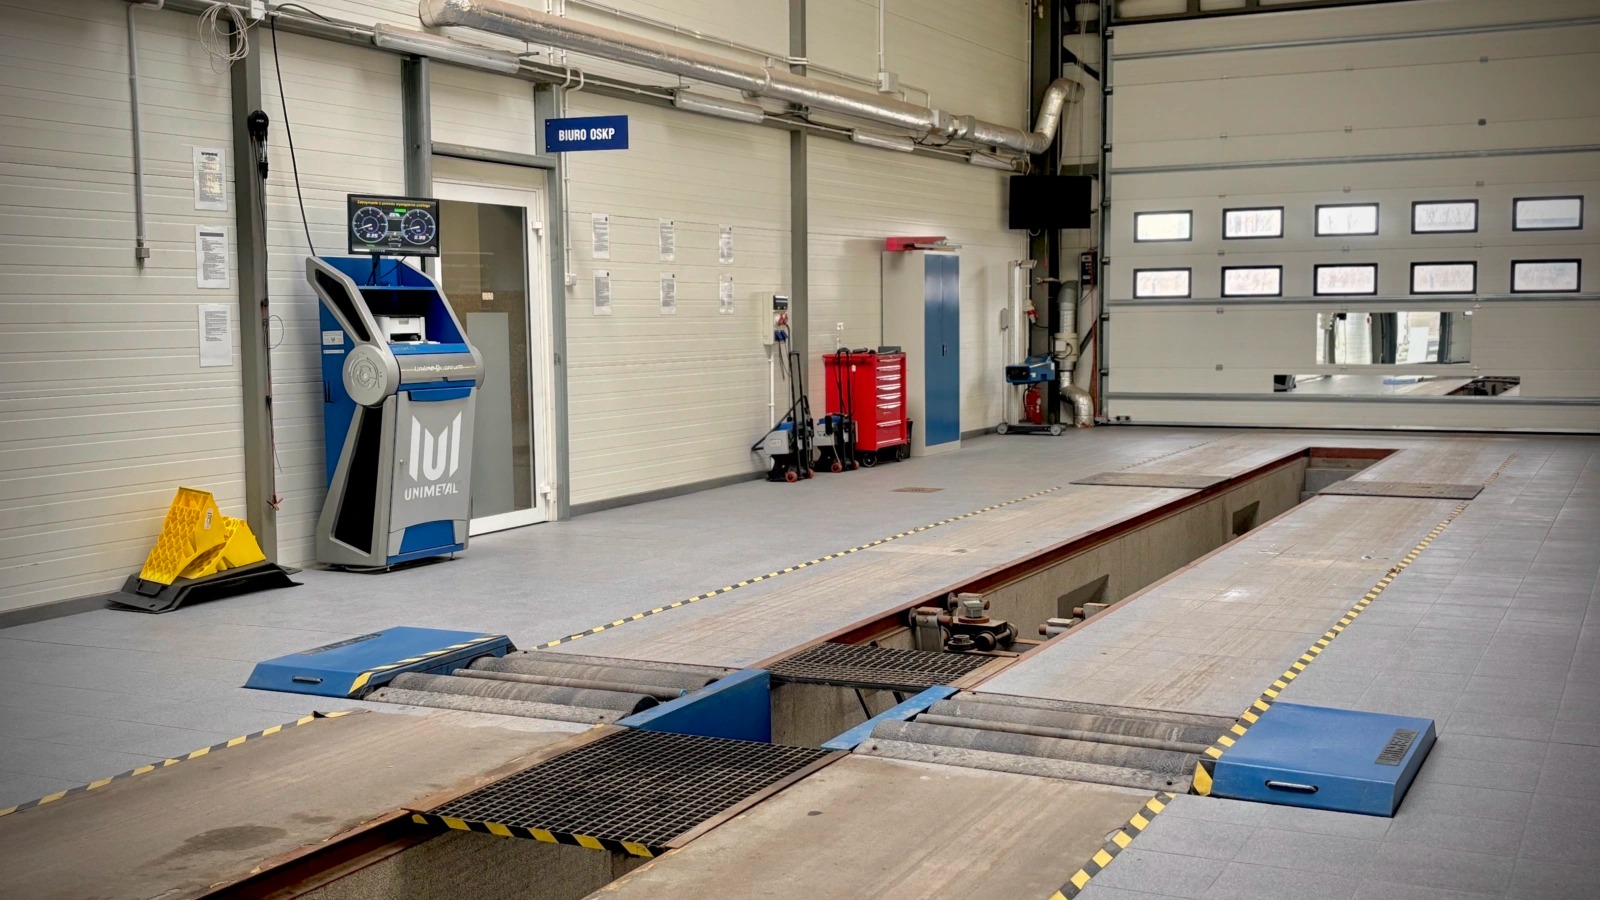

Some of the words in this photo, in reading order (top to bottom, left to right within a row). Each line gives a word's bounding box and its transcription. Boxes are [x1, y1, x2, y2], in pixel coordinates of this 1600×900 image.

[558, 129, 587, 141] BIURO
[590, 128, 615, 140] OSKP
[404, 482, 458, 500] UNIMETAL
